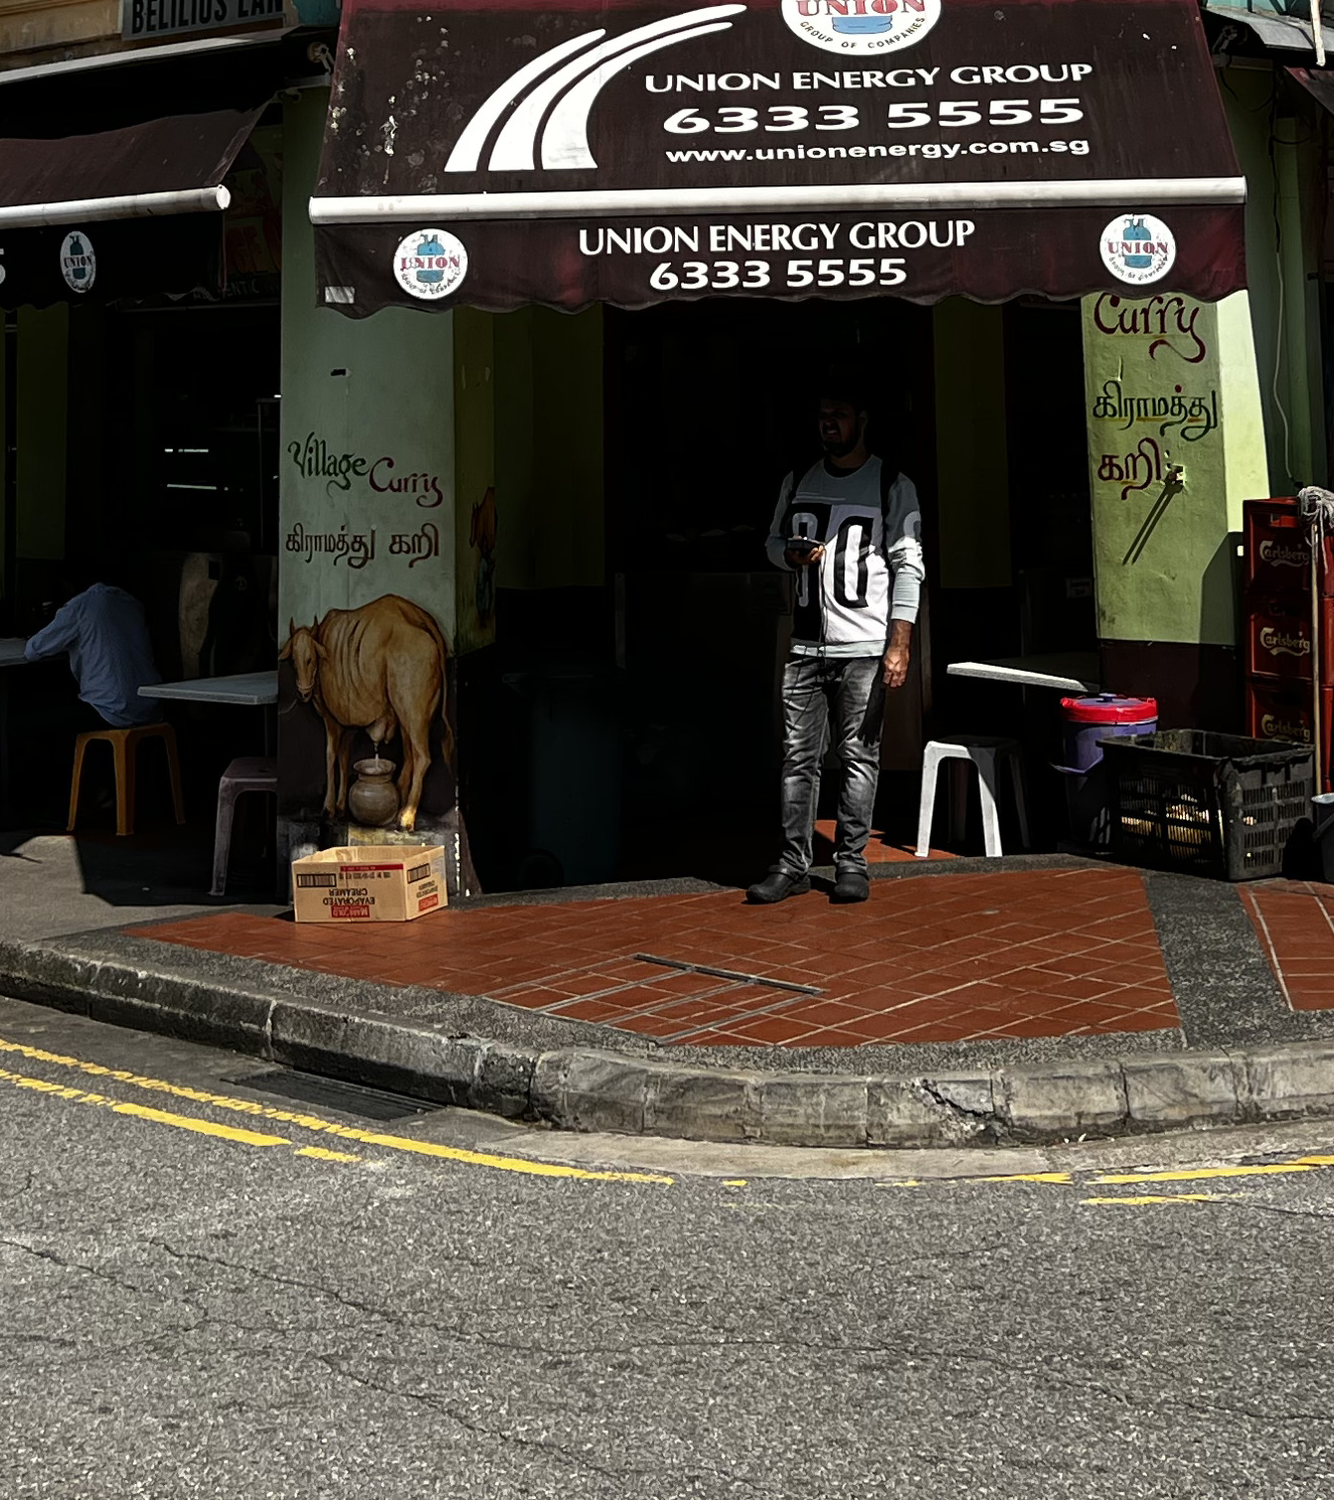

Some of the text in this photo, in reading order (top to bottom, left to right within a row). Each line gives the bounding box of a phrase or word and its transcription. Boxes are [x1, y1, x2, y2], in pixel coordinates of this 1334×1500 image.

[800, 17, 925, 49] GROUP OF COMPANIES
[644, 63, 1093, 93] UNION ENERGY GROUP
[662, 98, 1085, 134] 6333 5555
[665, 137, 1090, 164] www.unionenergy.com.sg
[578, 219, 975, 256] UNION ENERGY GROUP
[1108, 242, 1168, 254] UNION
[648, 258, 907, 291] 6333 5555
[1094, 291, 1206, 363] Curry
[1092, 380, 1217, 442] கிராமத்து
[288, 432, 443, 508] Village Curry
[1097, 437, 1163, 500] கறி
[286, 522, 439, 569] கிராமத்து கறி
[1259, 540, 1310, 565] Carlsberg
[1260, 627, 1310, 654] Carlsberg
[1261, 714, 1310, 741] Carlsberg
